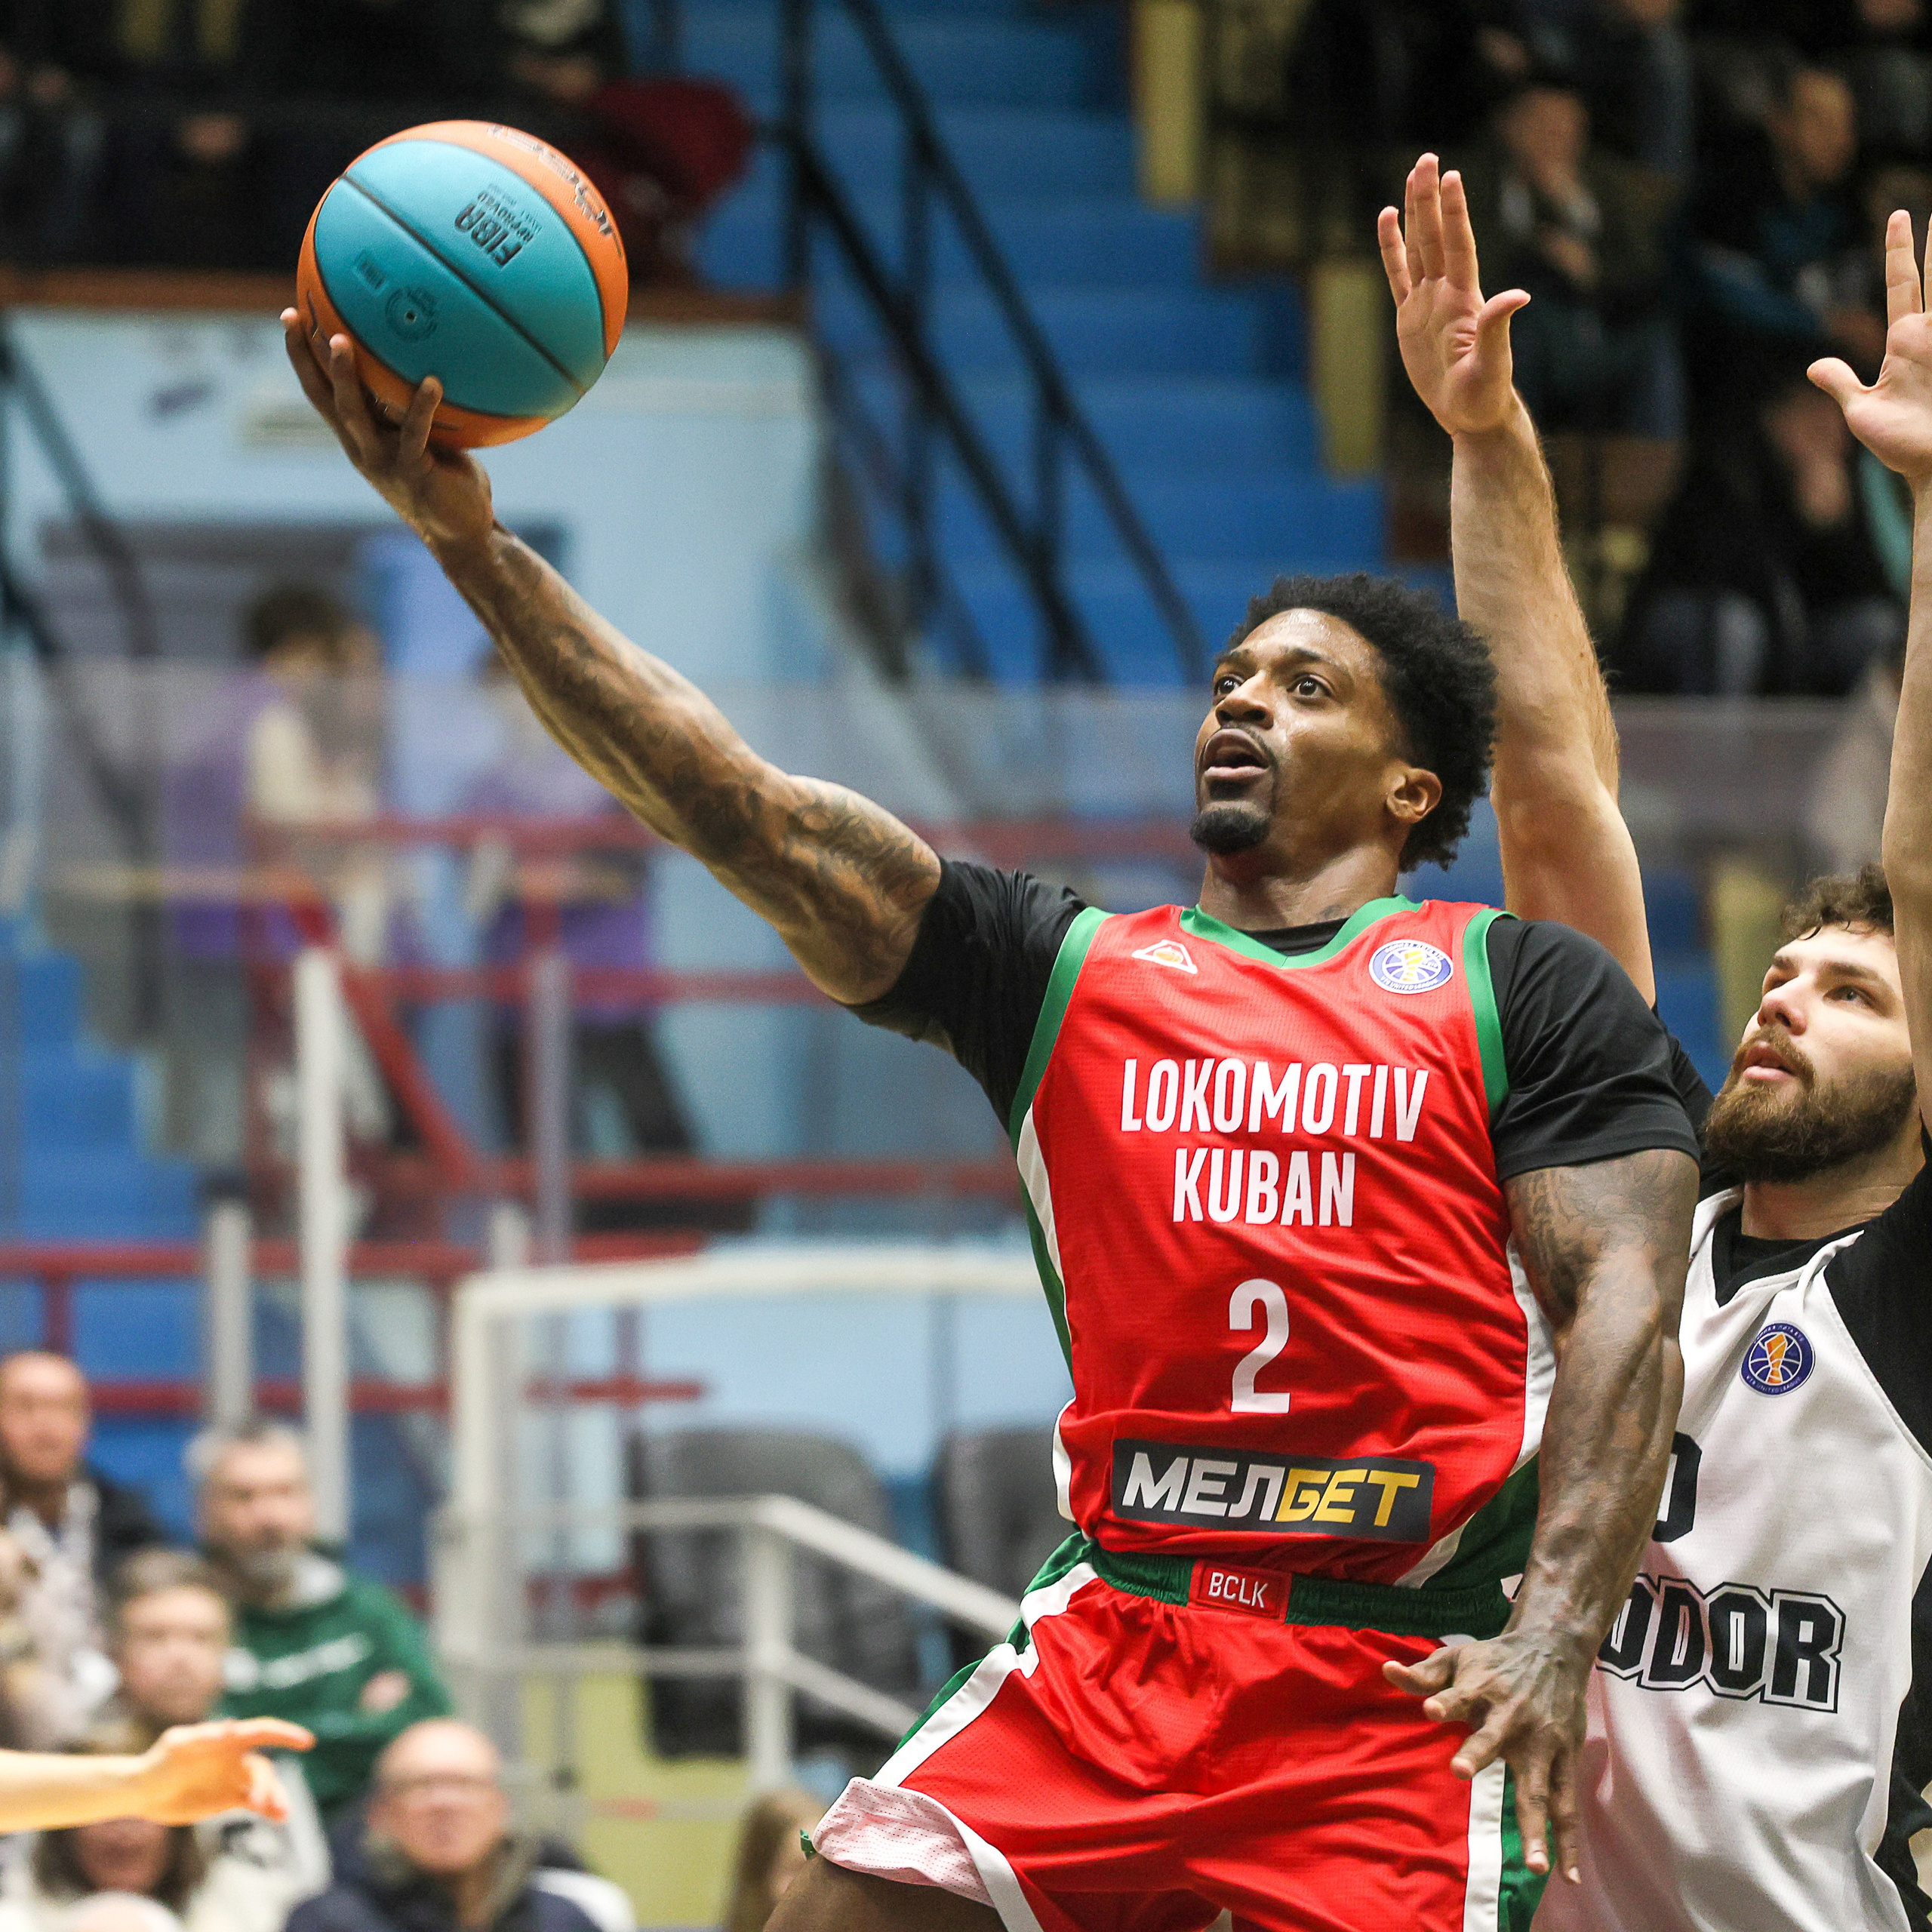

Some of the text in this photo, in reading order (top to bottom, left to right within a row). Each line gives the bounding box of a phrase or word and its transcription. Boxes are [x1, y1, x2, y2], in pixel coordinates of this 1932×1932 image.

[454, 202, 522, 266] FIBA
[1121, 1058, 1429, 1142] LOKOMOTIV
[1173, 1148, 1355, 1226] KUBAN
[1229, 1278, 1290, 1414] 2
[1122, 1452, 1421, 1527] МЕЛБЕТ
[1208, 1571, 1269, 1609] BCLK
